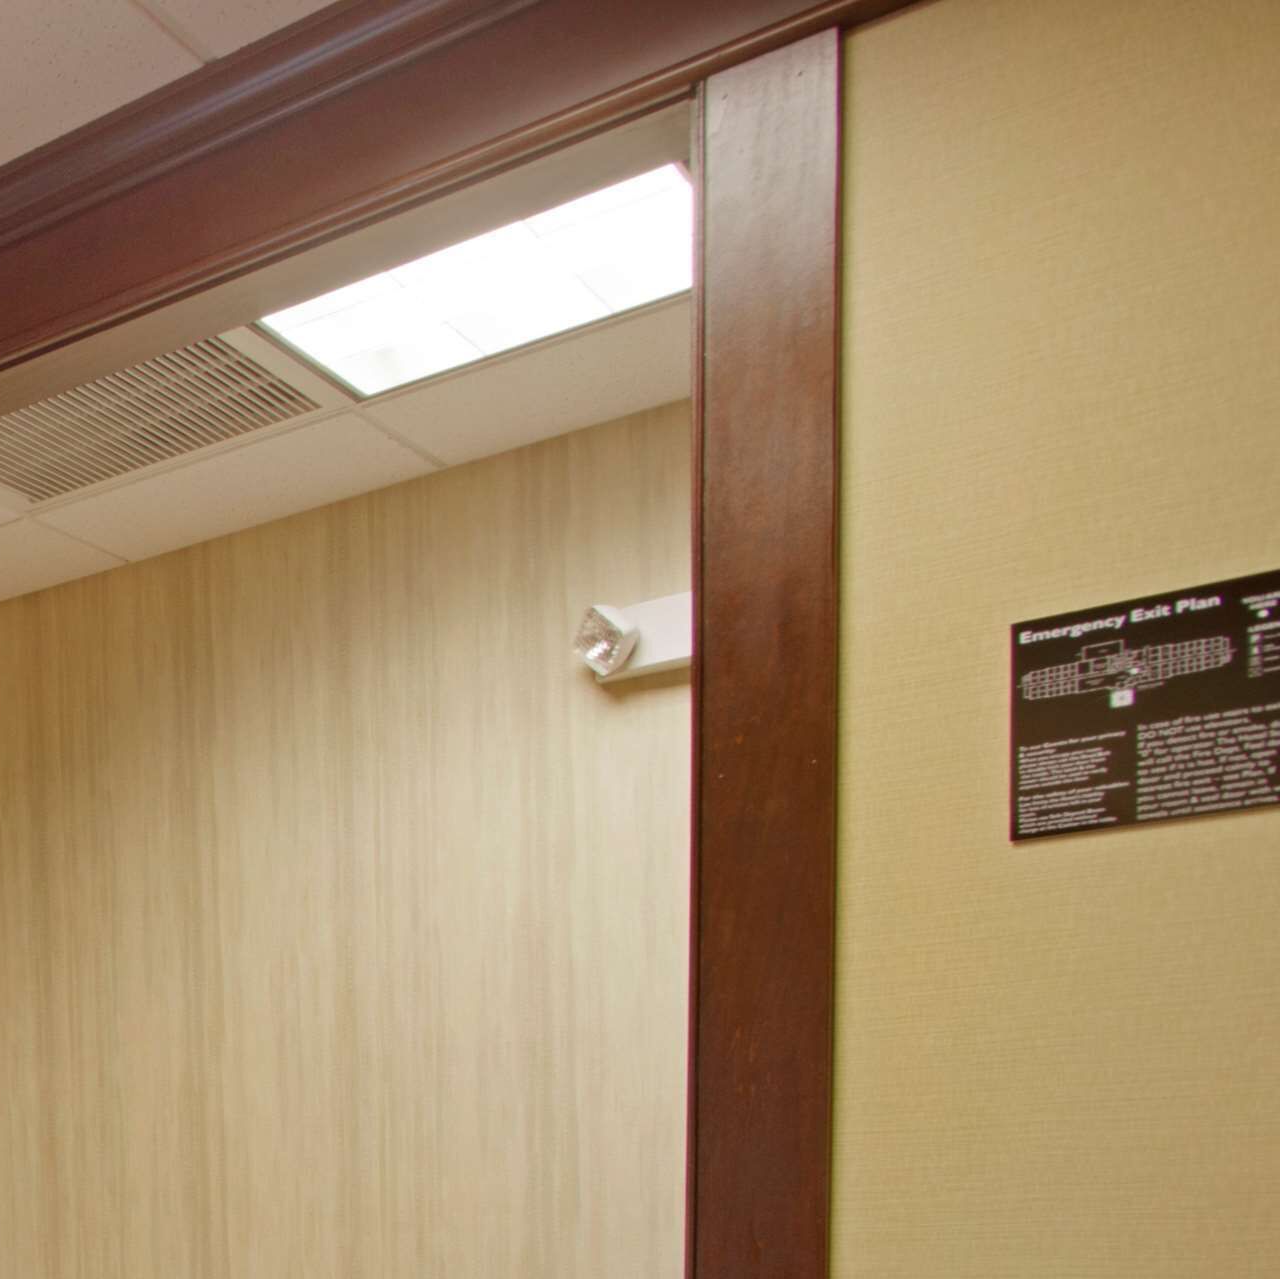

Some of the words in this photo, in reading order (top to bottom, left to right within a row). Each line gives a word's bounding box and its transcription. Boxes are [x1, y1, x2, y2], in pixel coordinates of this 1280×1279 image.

[1018, 614, 1127, 645] Emergency
[1129, 604, 1173, 623] Exit
[1175, 593, 1222, 615] Plan
